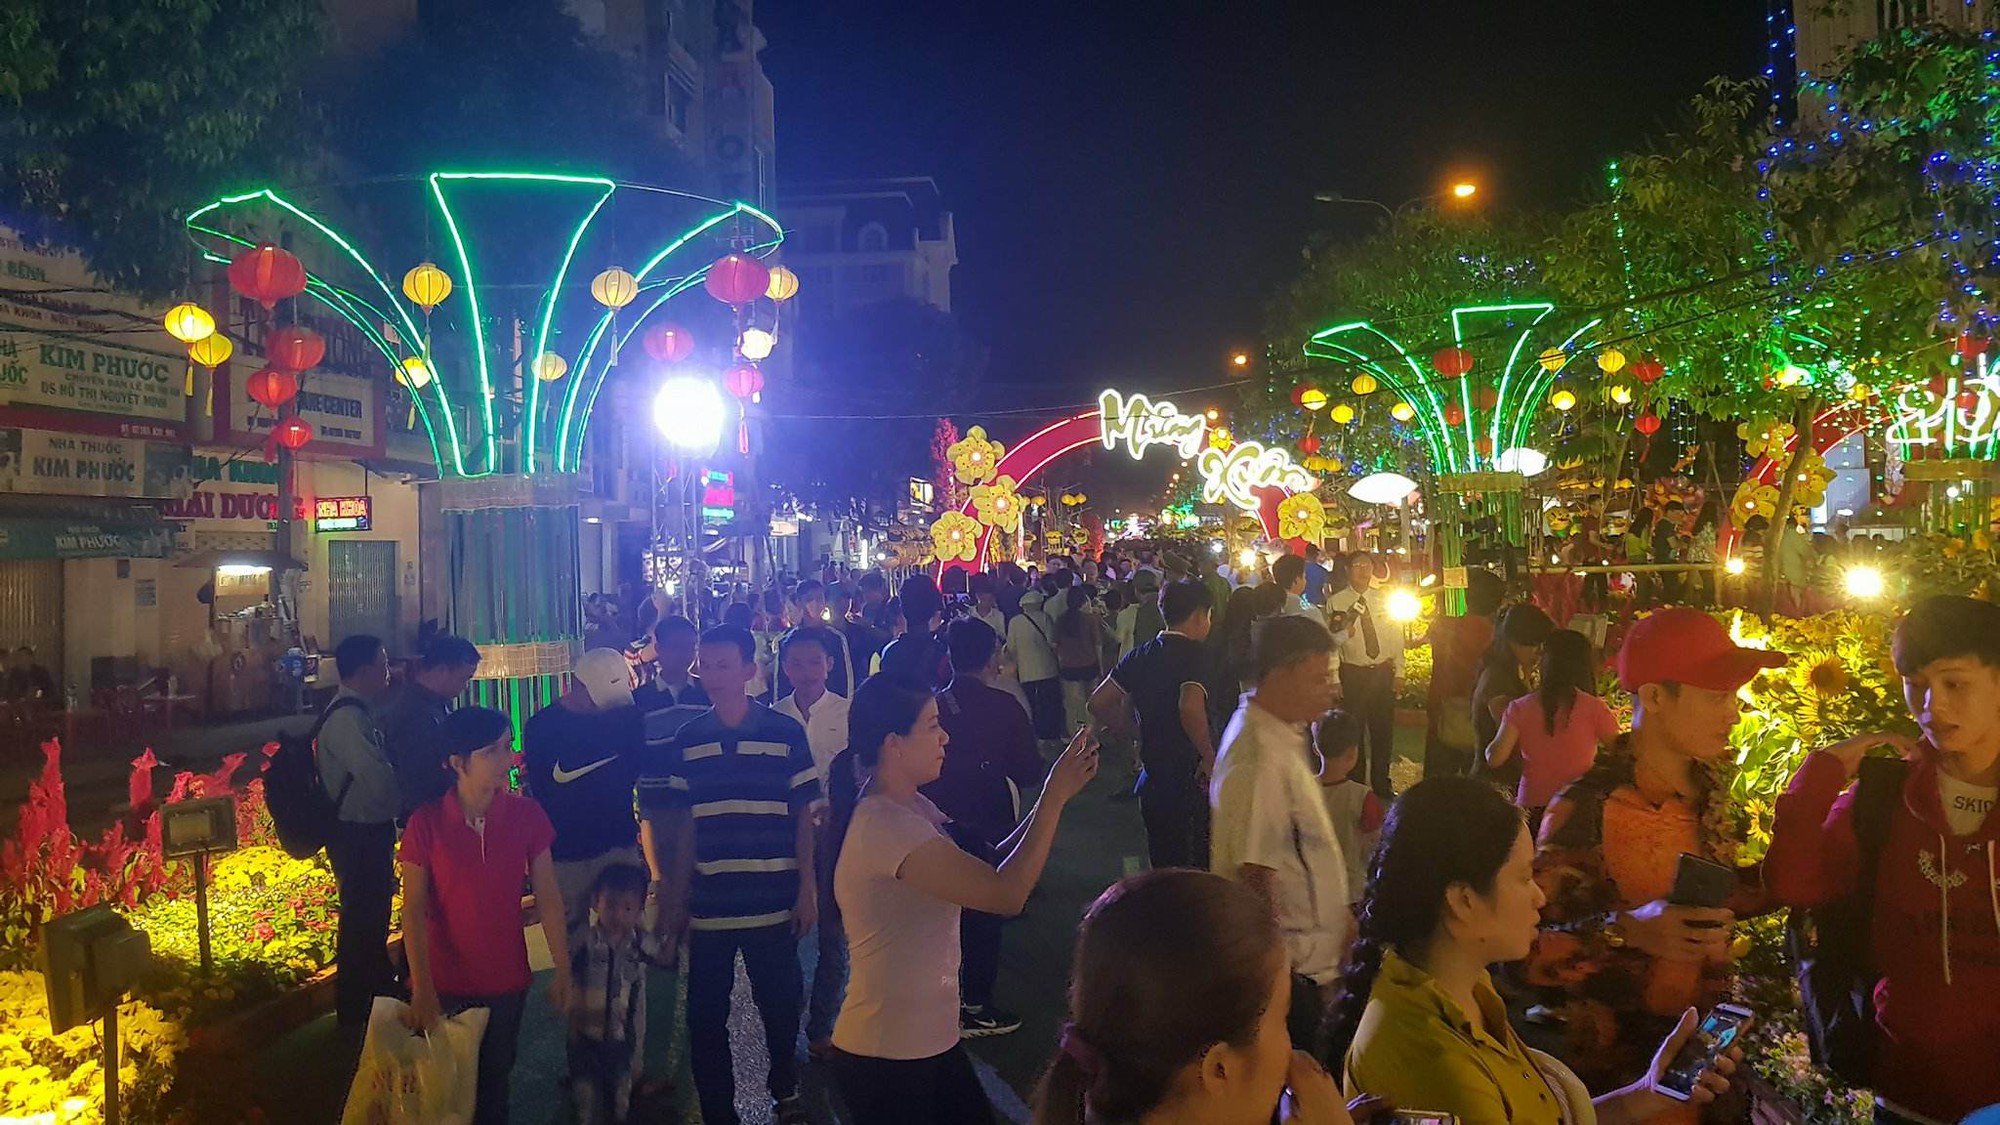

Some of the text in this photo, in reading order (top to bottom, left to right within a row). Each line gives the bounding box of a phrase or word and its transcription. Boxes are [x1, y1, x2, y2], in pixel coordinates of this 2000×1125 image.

[40, 343, 170, 382] KIM PHƯỚC
[33, 456, 70, 478] KIM
